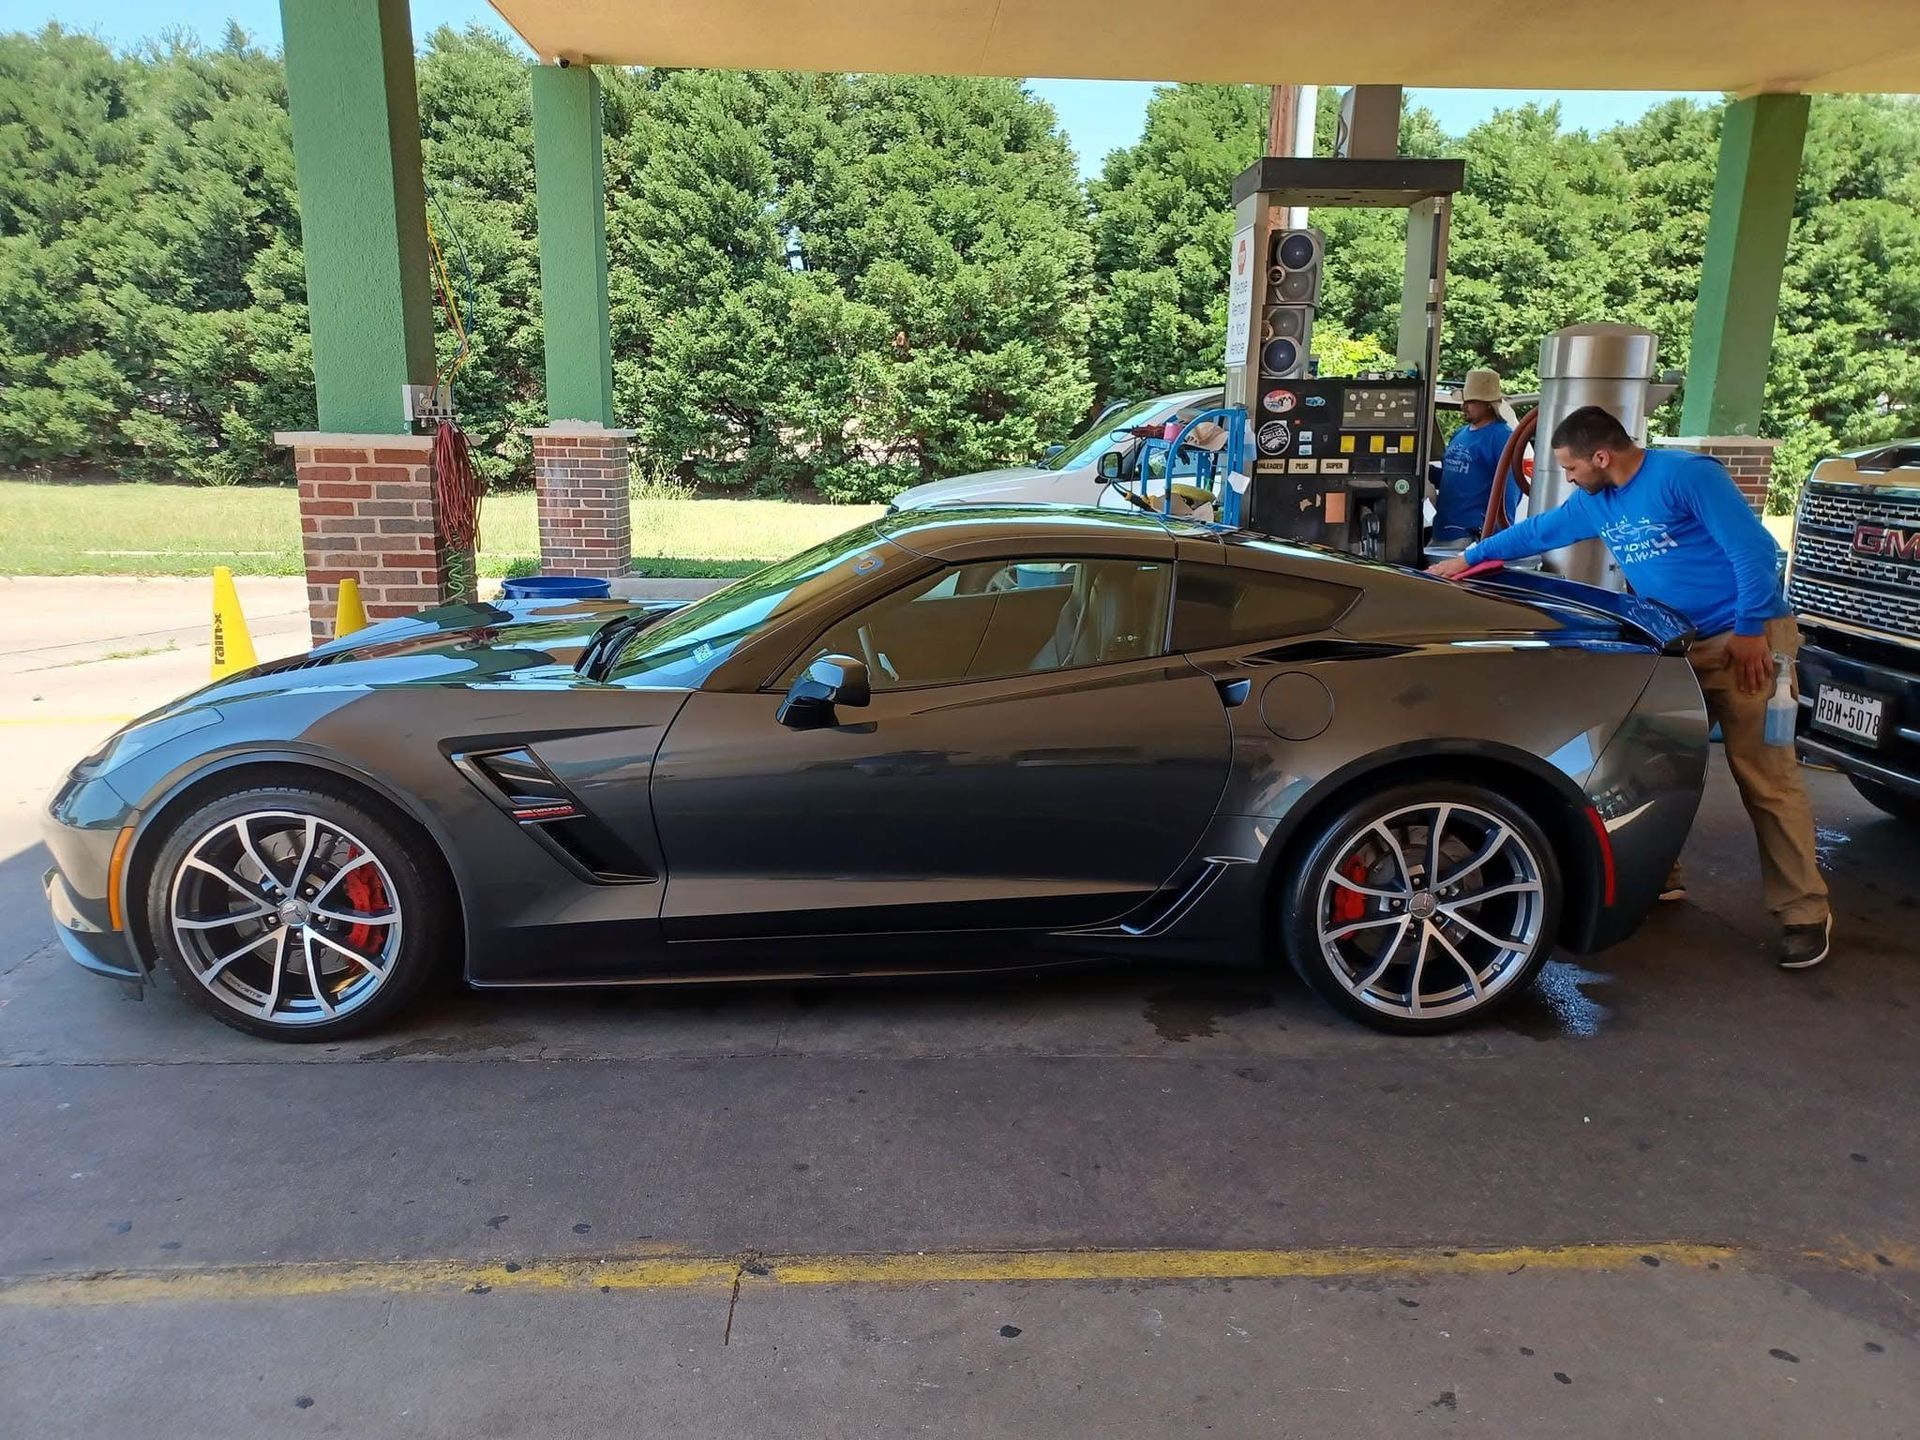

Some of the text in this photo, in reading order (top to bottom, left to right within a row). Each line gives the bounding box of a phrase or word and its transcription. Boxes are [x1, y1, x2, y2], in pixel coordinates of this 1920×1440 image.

[1295, 462, 1309, 470] PLUS
[1325, 462, 1343, 470] SUPER
[1840, 691, 1864, 705] TEXAS
